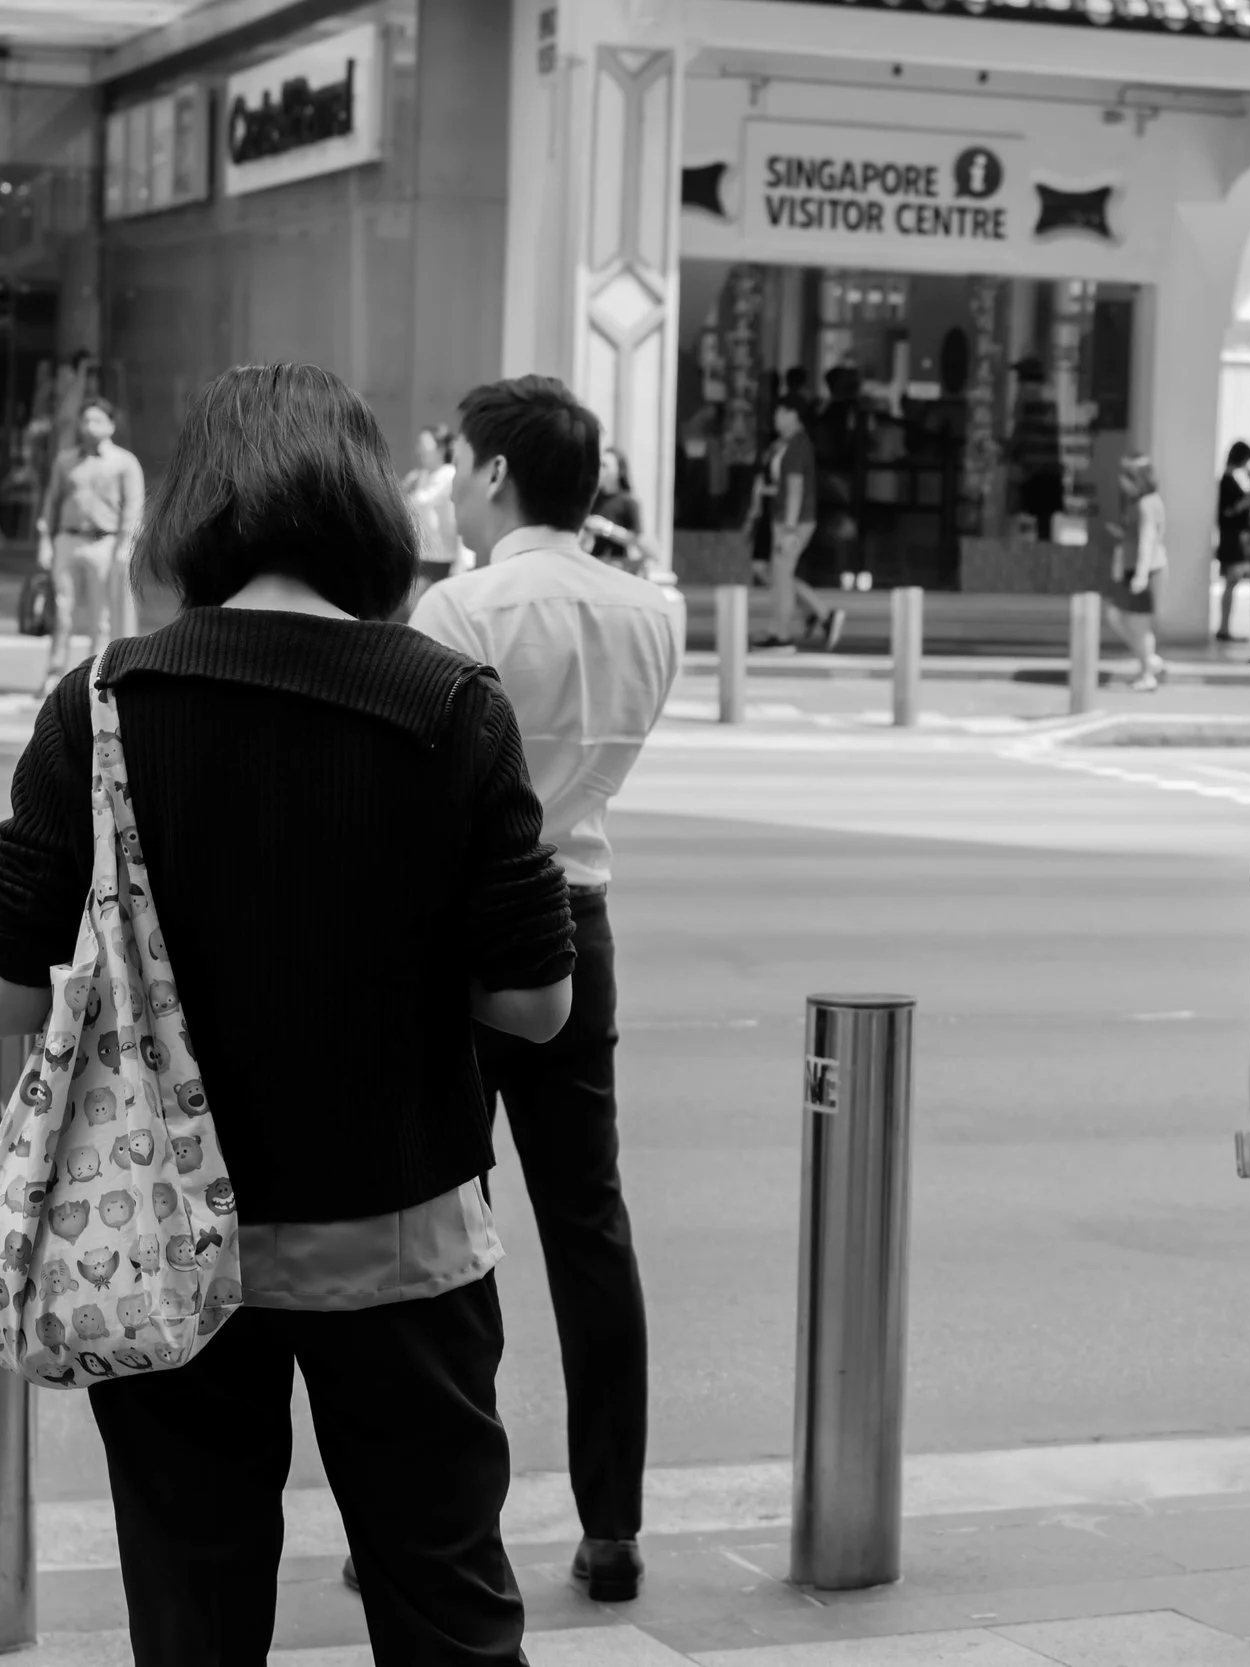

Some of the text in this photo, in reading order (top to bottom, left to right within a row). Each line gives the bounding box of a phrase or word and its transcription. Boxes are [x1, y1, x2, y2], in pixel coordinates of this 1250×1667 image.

[765, 155, 938, 197] SINGAPORE
[766, 195, 1006, 240] VISITOR CENTRE
